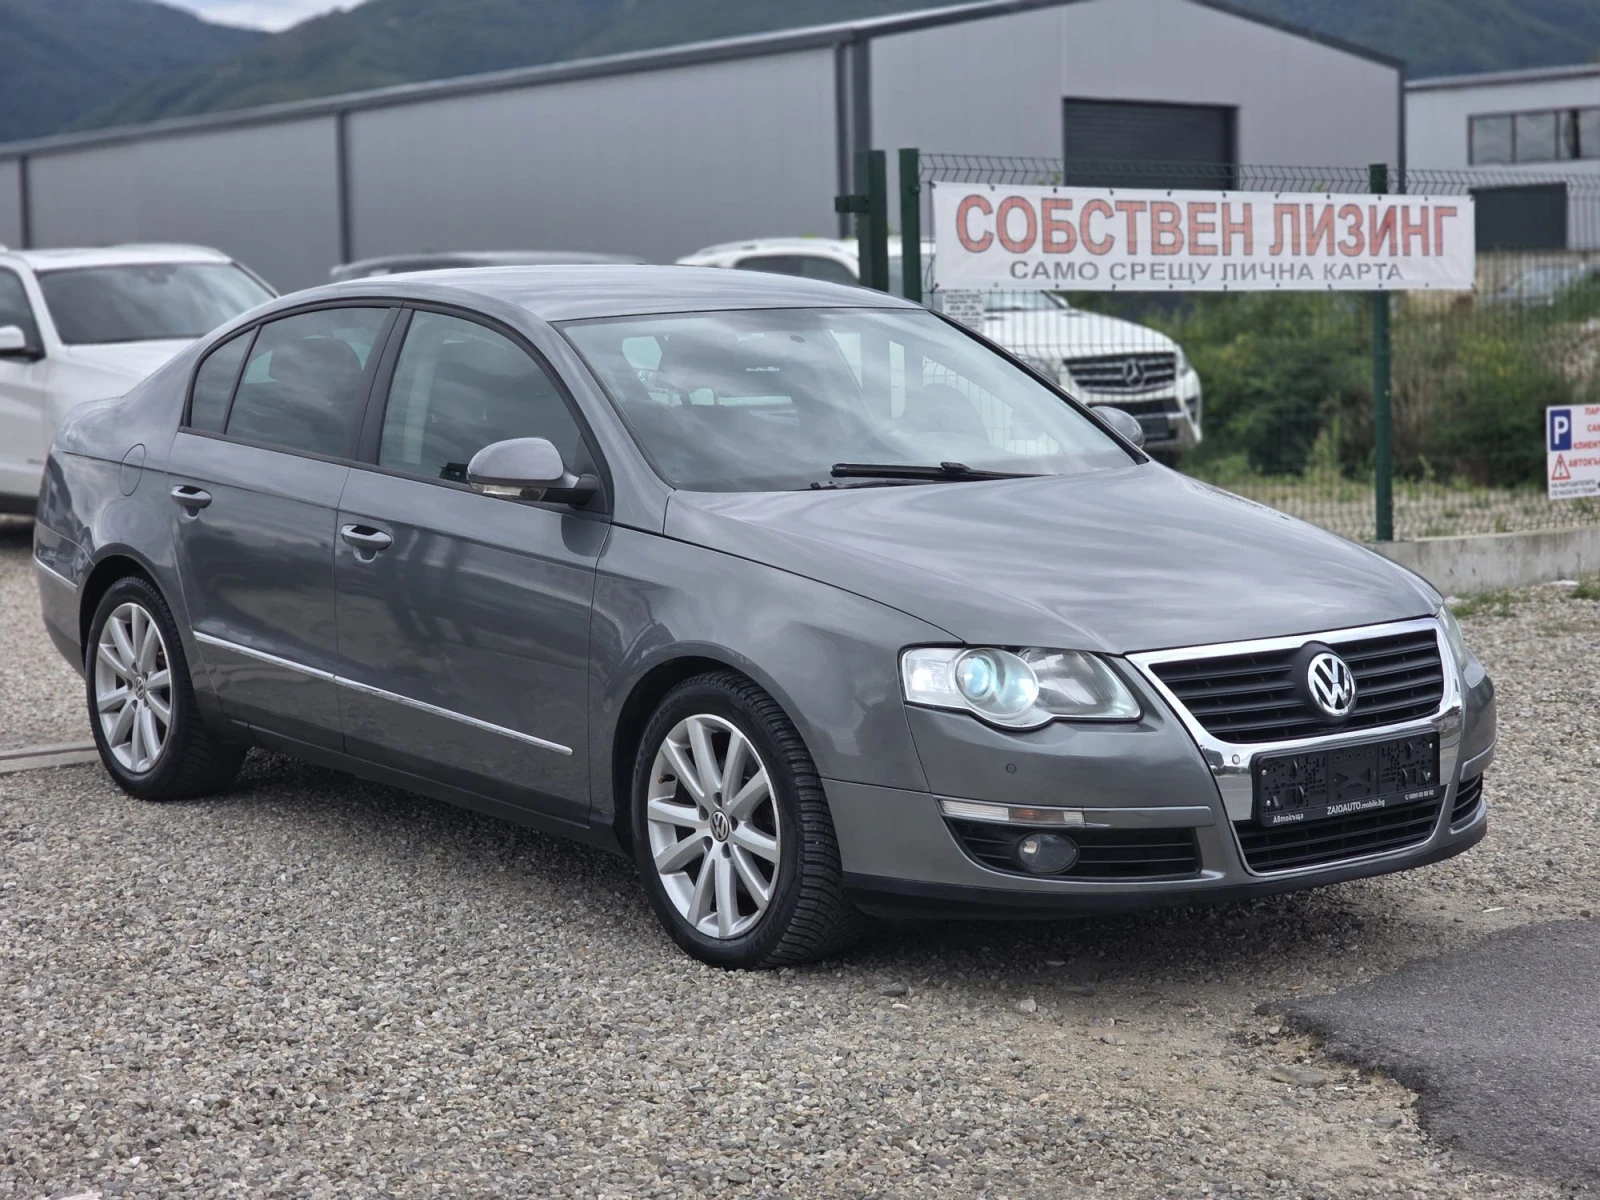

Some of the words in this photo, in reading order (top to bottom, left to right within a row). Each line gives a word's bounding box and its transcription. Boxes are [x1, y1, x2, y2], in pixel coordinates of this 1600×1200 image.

[955, 194, 1254, 256] СОБСТВЕН
[1269, 202, 1459, 257] ЛИЗИНГ
[1009, 260, 1100, 281] САМО
[1109, 261, 1212, 283] СРЕЩУ
[1220, 262, 1314, 282] ЛИЧНА
[1323, 262, 1404, 281] КАРТА
[1553, 416, 1569, 445] P
[1308, 653, 1355, 716] VW
